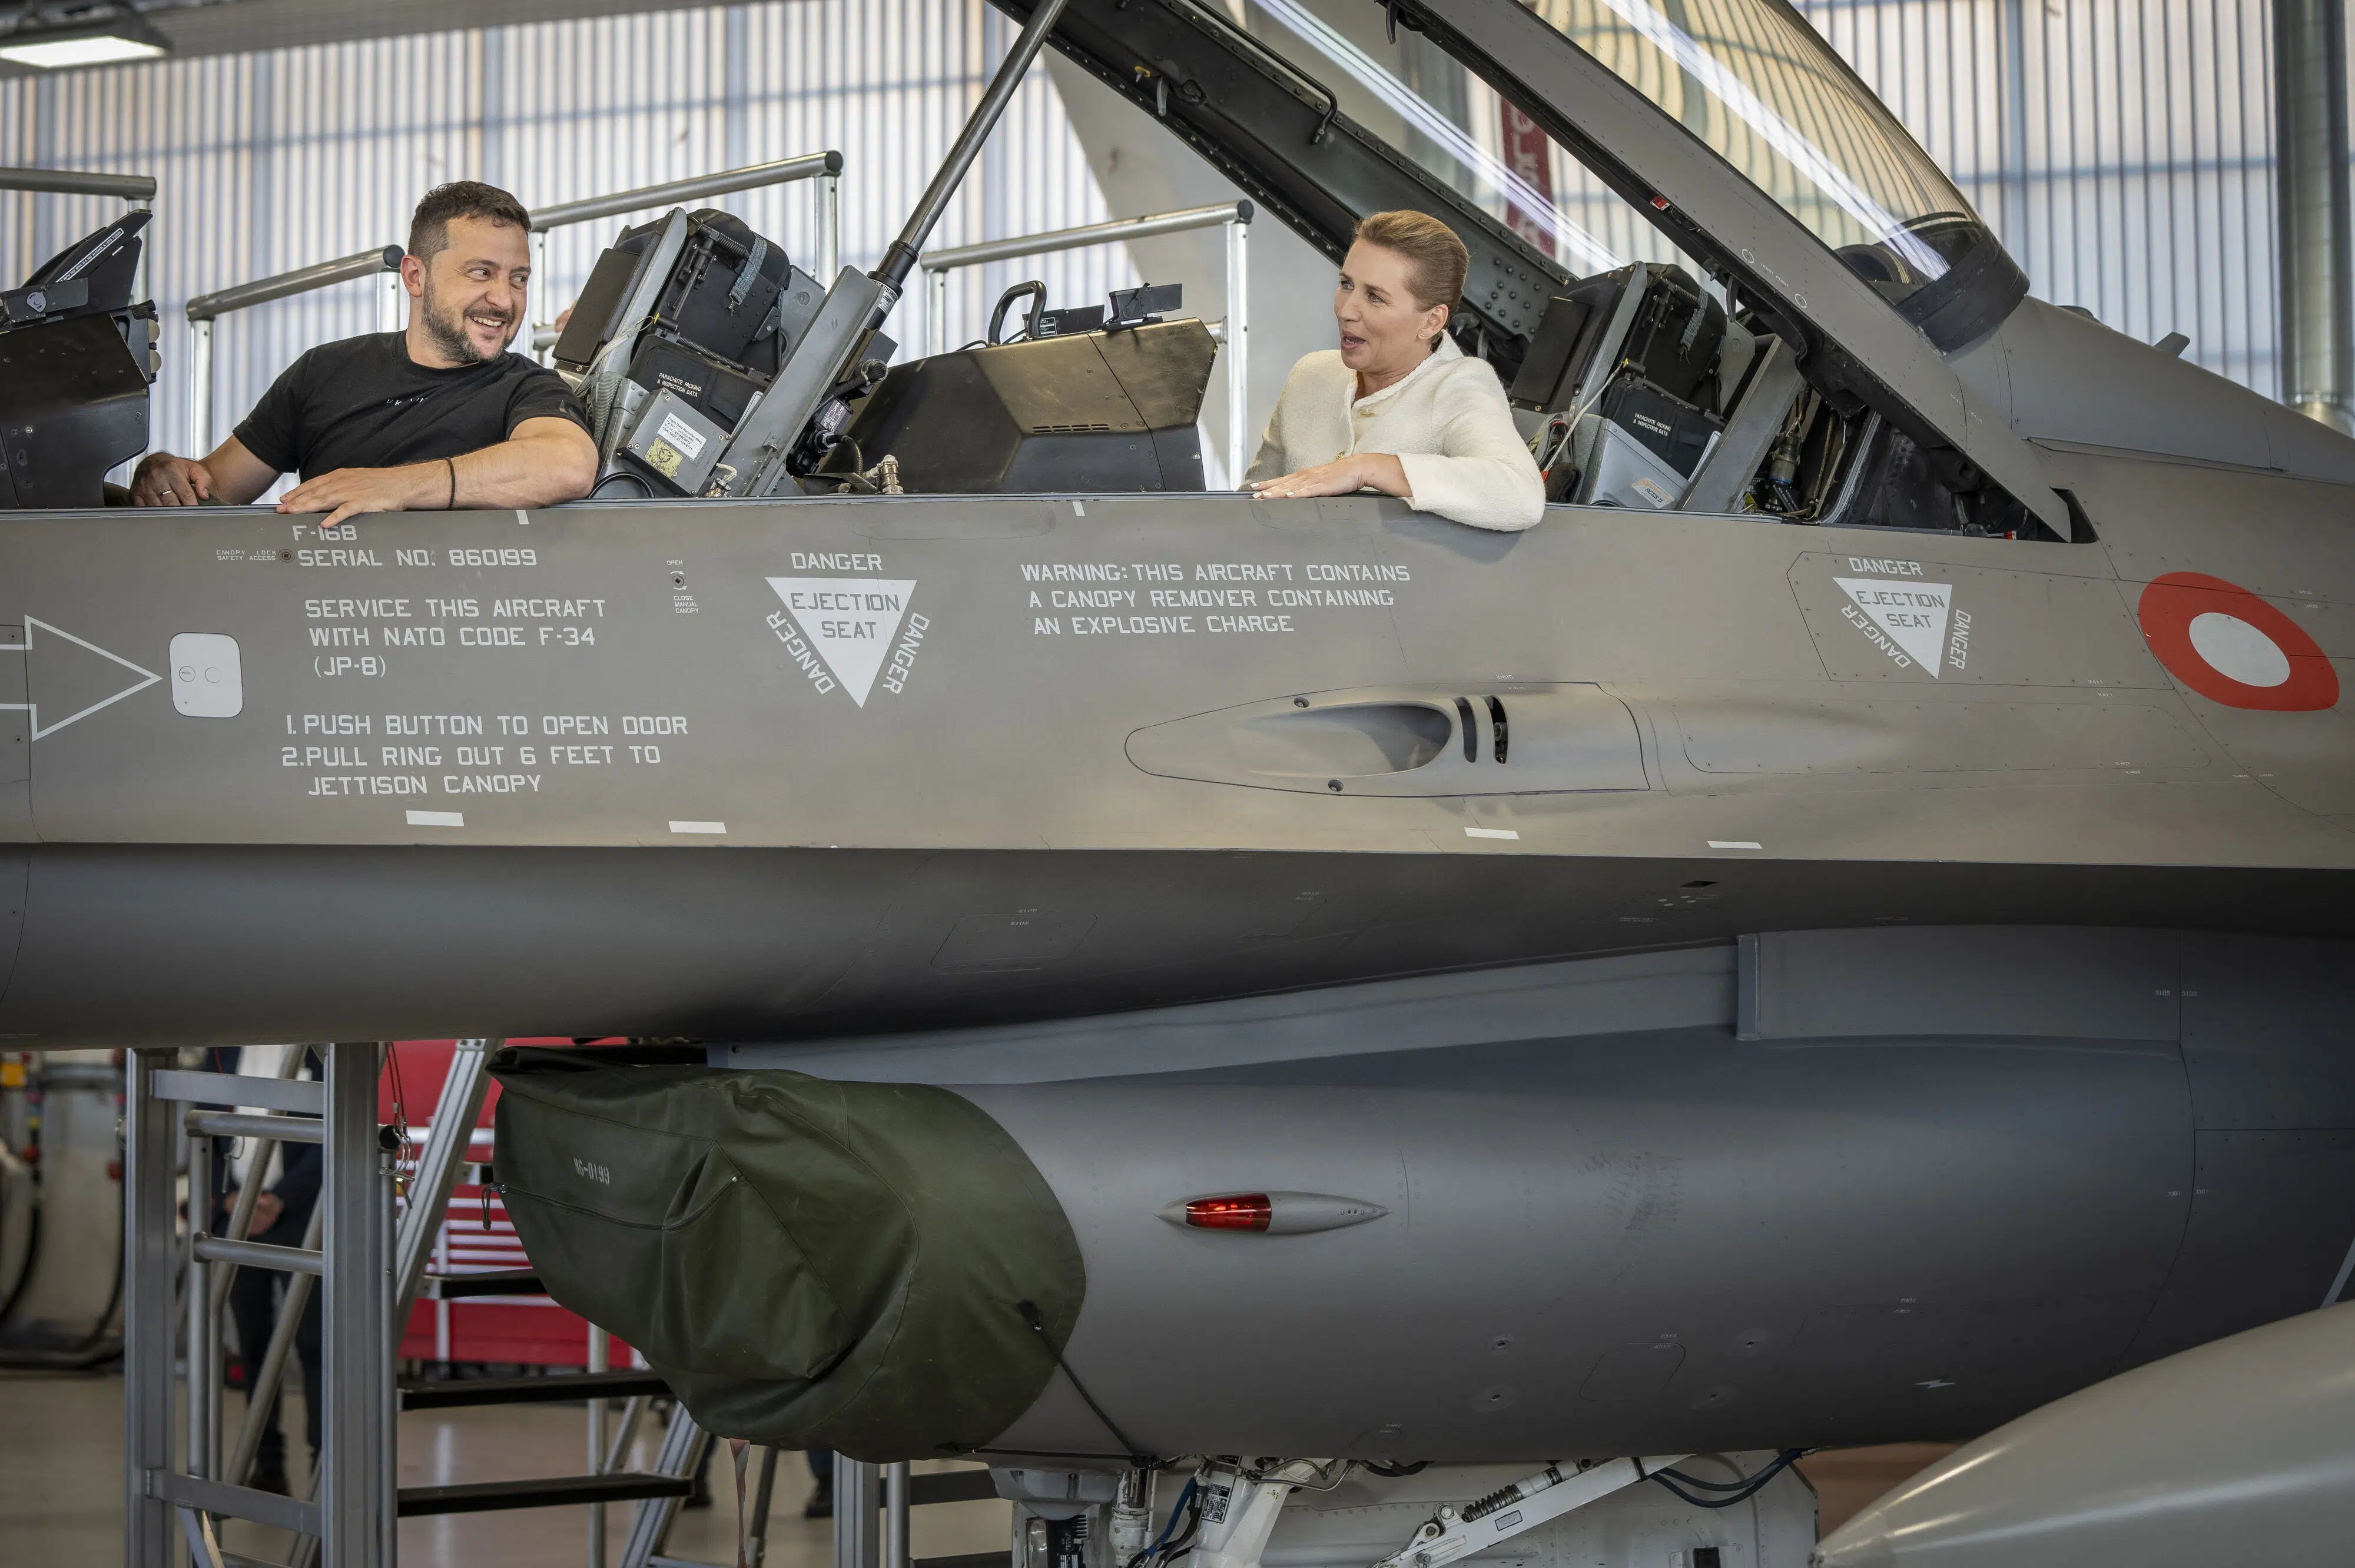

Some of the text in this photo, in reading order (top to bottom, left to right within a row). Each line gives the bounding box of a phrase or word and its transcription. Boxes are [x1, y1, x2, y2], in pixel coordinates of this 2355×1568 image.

[659, 373, 702, 391] PARACHUTE PACKING
[662, 380, 686, 393] INSPECTION
[686, 389, 698, 397] DATA
[1634, 413, 1671, 431] PARACHUTE PACKING
[1637, 420, 1659, 433] INSPECTION
[1659, 428, 1668, 437] DATA
[1645, 488, 1659, 499] ACES
[293, 525, 357, 541] F-16B
[298, 550, 383, 566] SERIAL
[449, 549, 536, 566] 860199
[791, 553, 883, 570] DANGER
[1849, 558, 1923, 575] DANGER
[1196, 564, 1292, 580] AIRCRAFT
[1306, 565, 1410, 580] CONTAINS
[791, 593, 900, 612] EJECTION
[1030, 590, 1394, 607] A CANOPY REMOVER CONTAINING
[1856, 590, 1945, 607] EJECTION
[306, 599, 605, 617] SERVICE THIS AIRCRAFT
[821, 620, 877, 639] SEAT
[1035, 616, 1294, 634] AN EXPLOSIVE CHARGE
[1886, 613, 1931, 628] SEAT
[309, 627, 595, 646] WITH NATO CODE F-34
[1841, 604, 1912, 668] DANGER
[1949, 609, 1971, 669] DANGER
[766, 610, 835, 695] DANGER
[883, 612, 930, 694] DANGER
[315, 656, 385, 677] (JP-8)
[386, 716, 482, 735] BUTTON
[497, 716, 528, 735] TO
[543, 716, 608, 734] OPEN
[623, 716, 688, 734] DOOR
[382, 747, 442, 765] RING
[457, 747, 503, 765] OUT
[520, 747, 536, 764] 6
[550, 746, 613, 763] FEET
[629, 746, 660, 763] TO
[309, 775, 540, 795] JETTISON CANOPY
[573, 1157, 609, 1184] 86-0199
